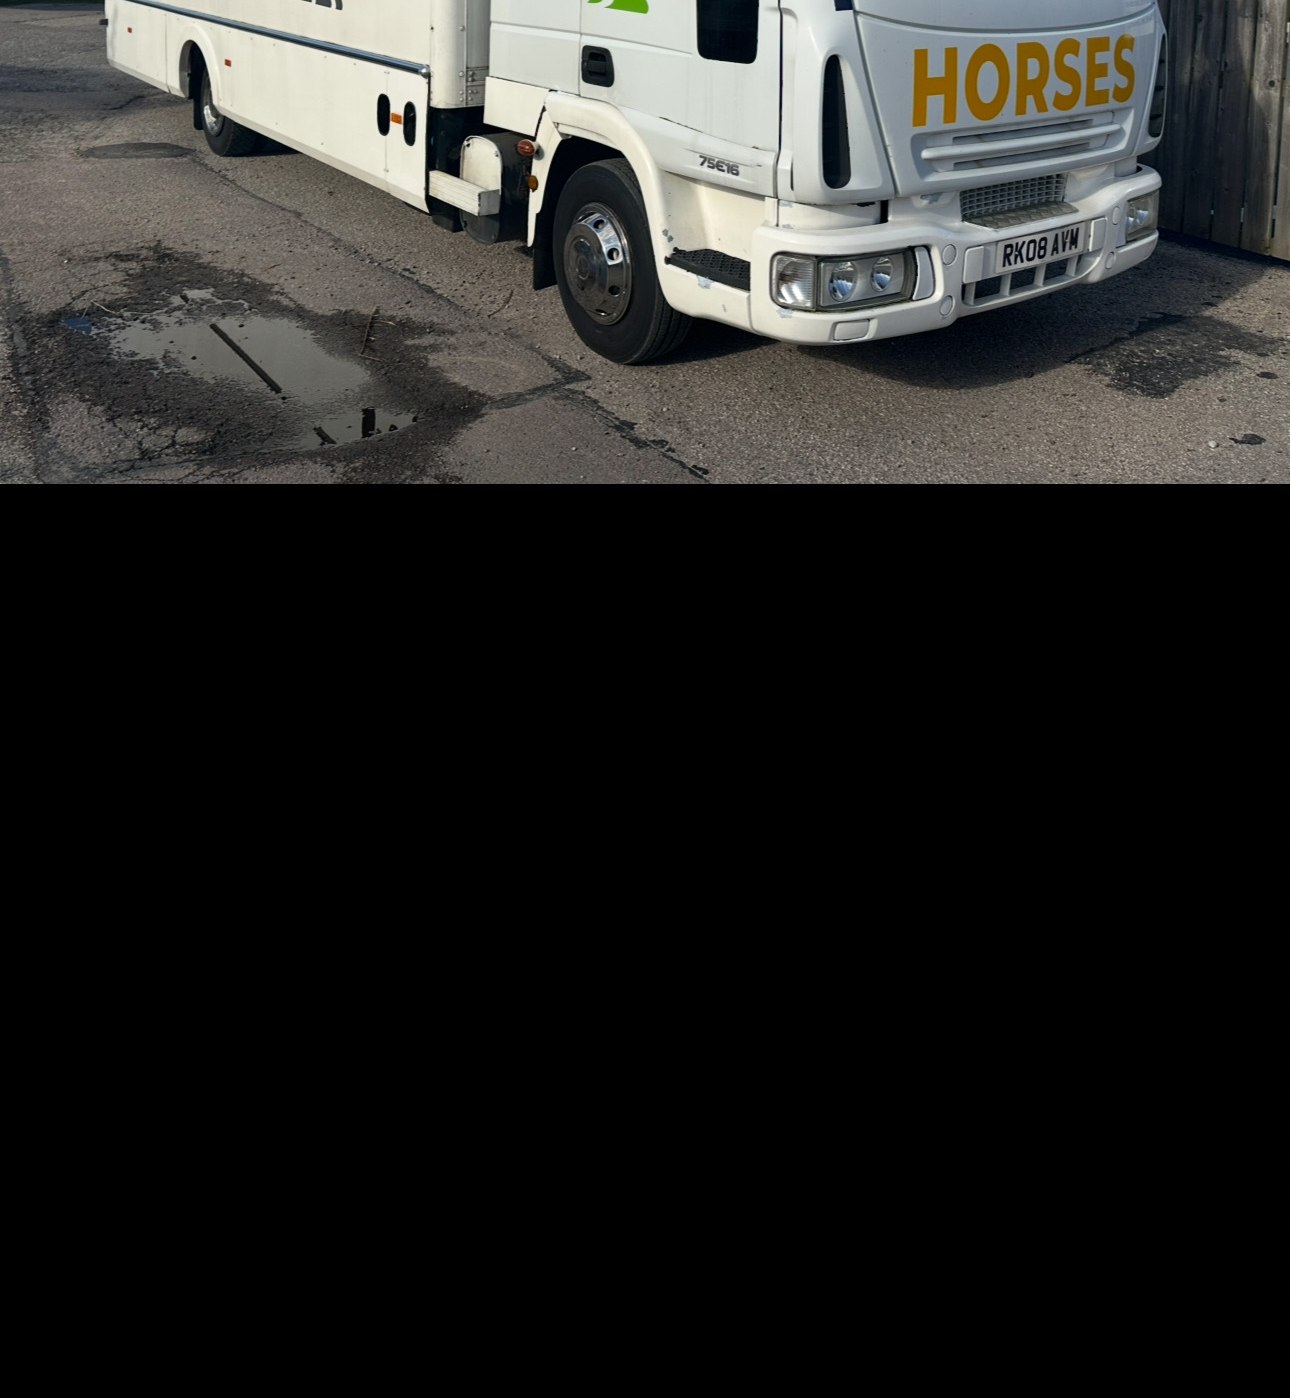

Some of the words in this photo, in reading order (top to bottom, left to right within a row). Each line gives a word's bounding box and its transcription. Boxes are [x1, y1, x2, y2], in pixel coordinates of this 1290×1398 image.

[912, 34, 1135, 127] HORSES
[699, 155, 739, 176] 75E16
[1002, 236, 1048, 267] RK08
[1051, 227, 1079, 256] AVM
